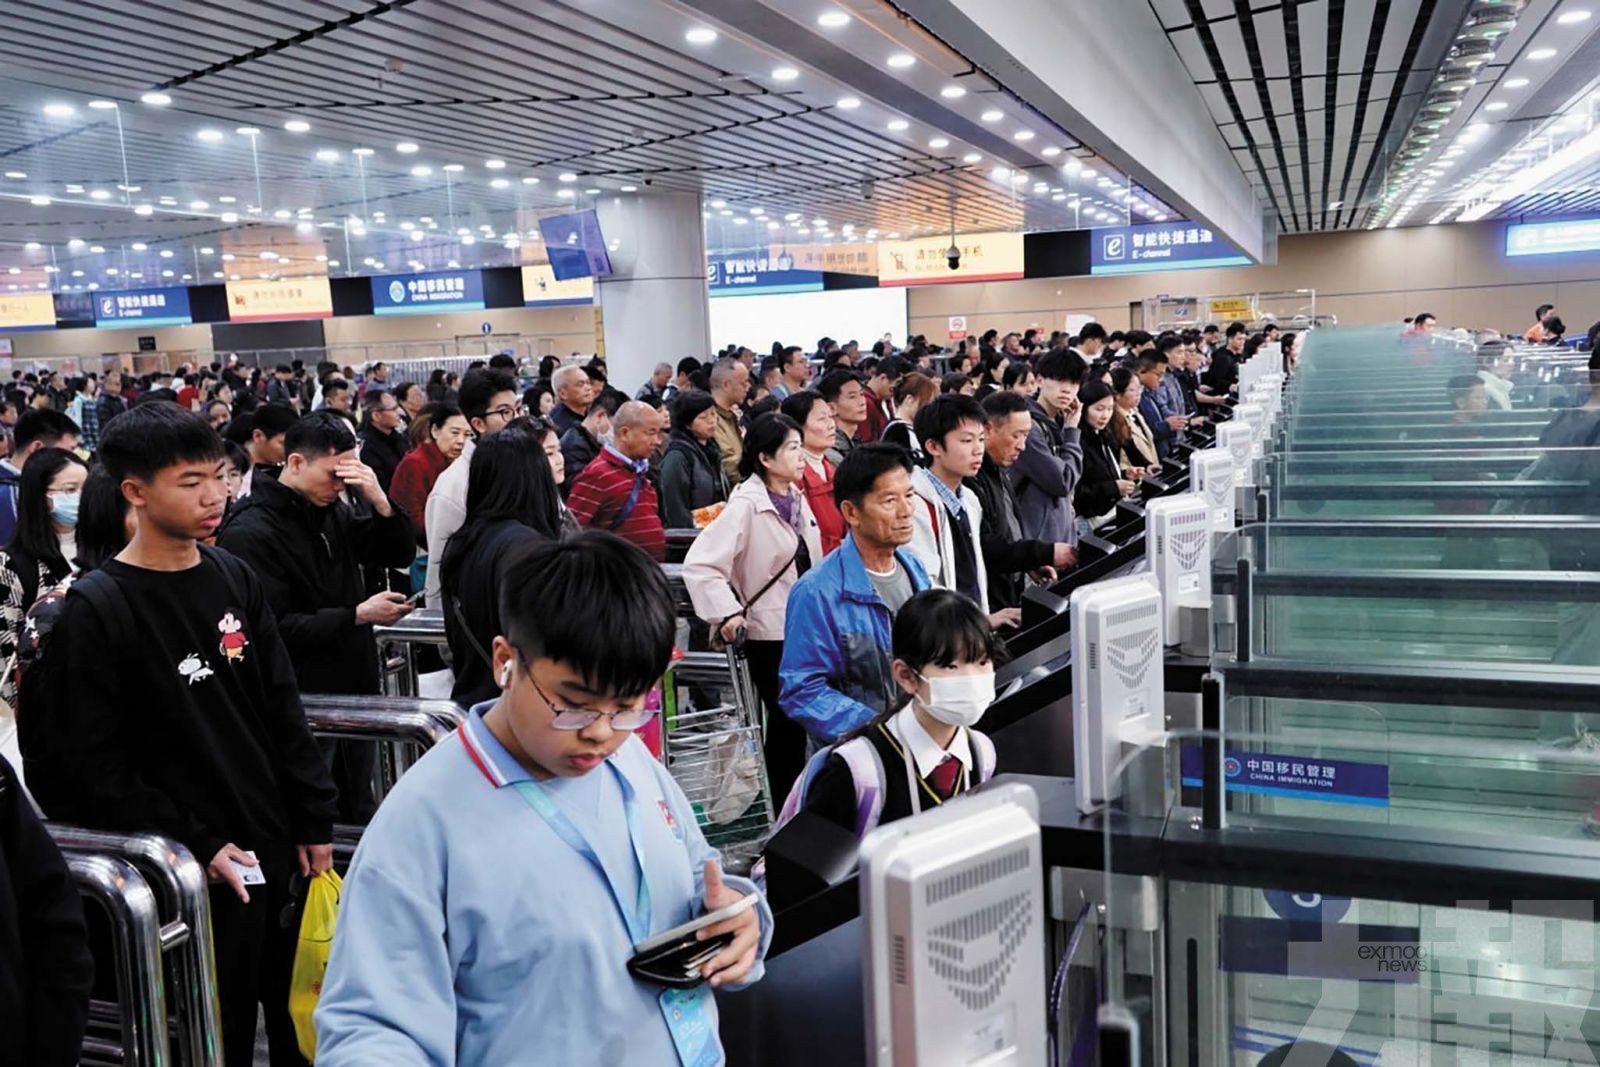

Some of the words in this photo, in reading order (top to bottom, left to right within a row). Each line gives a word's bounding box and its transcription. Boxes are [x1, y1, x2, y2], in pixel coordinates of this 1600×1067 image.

[1132, 228, 1213, 247] 智能快捷通道
[408, 277, 464, 293] 中国移民管理
[1247, 759, 1335, 779] 中国移民管理
[1249, 773, 1275, 781] CHINA
[1278, 776, 1333, 787] IMMIGRATION
